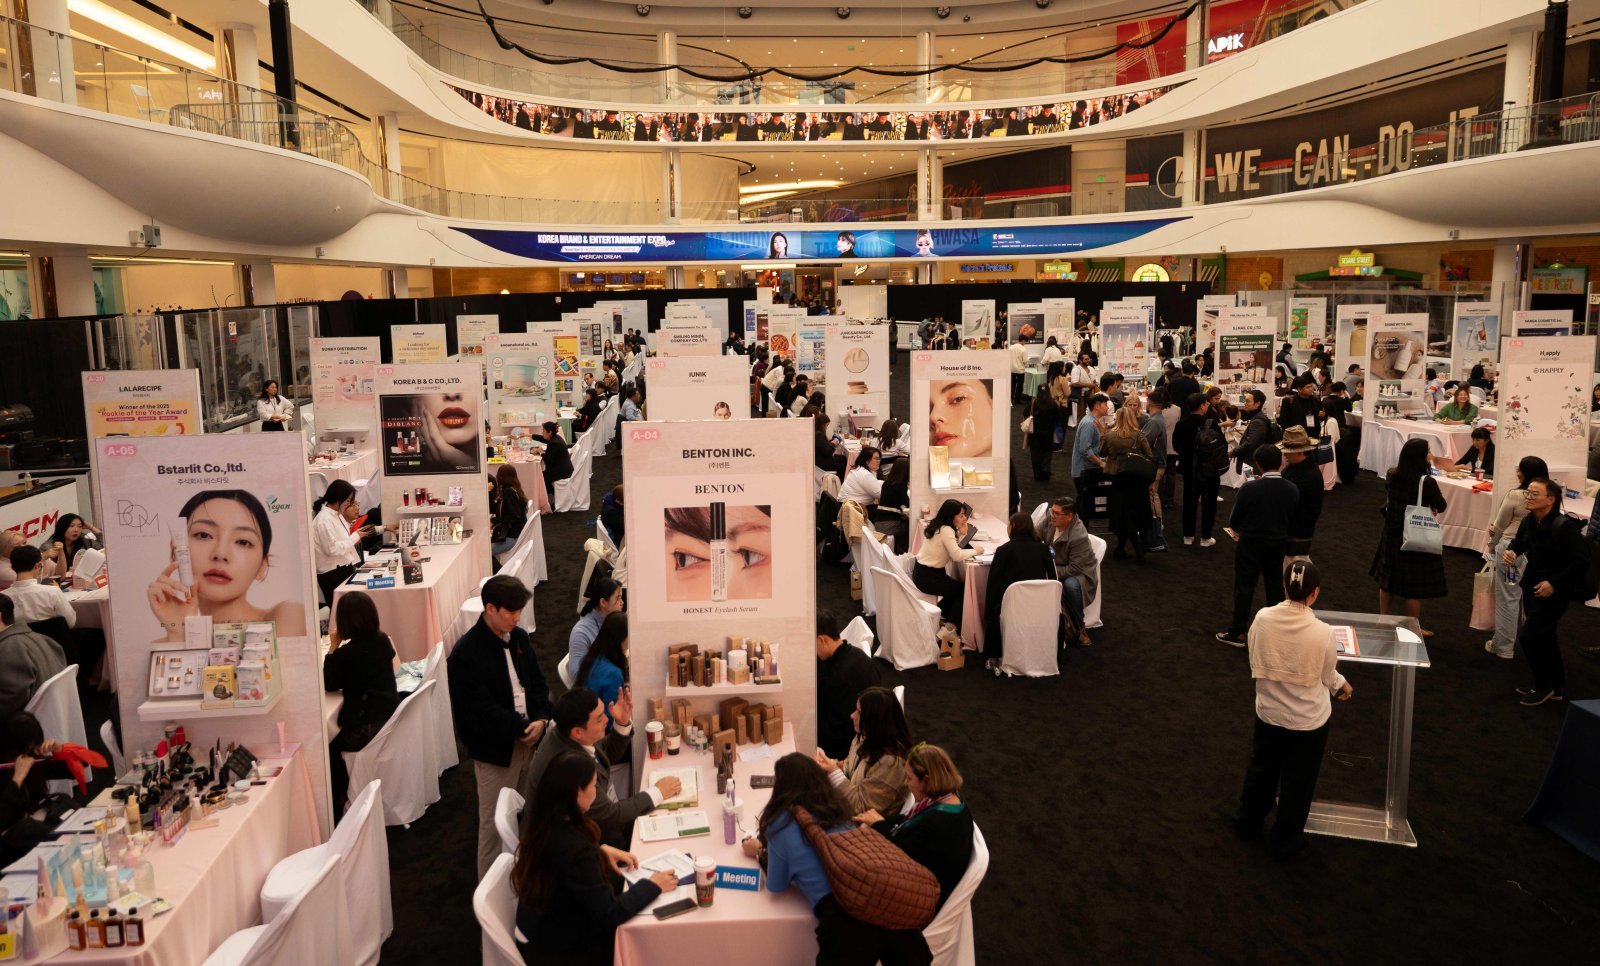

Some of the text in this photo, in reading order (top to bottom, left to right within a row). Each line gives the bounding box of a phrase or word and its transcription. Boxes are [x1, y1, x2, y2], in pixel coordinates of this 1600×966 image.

[1215, 106, 1479, 192] WE CAN DO IT
[538, 234, 559, 244] KOREA
[560, 234, 582, 244] BRAND
[583, 235, 588, 244] &
[589, 235, 646, 244] ENTERTAINMENT
[648, 236, 666, 245] EXPO
[632, 432, 658, 440] A-04
[107, 446, 134, 456] A-05
[682, 448, 755, 459] BENTON INC.
[157, 463, 246, 475] Bstarlit Co.,ltd.
[695, 484, 745, 494] BENTON
[266, 498, 291, 513] Vegan
[722, 872, 756, 884] Meeting
